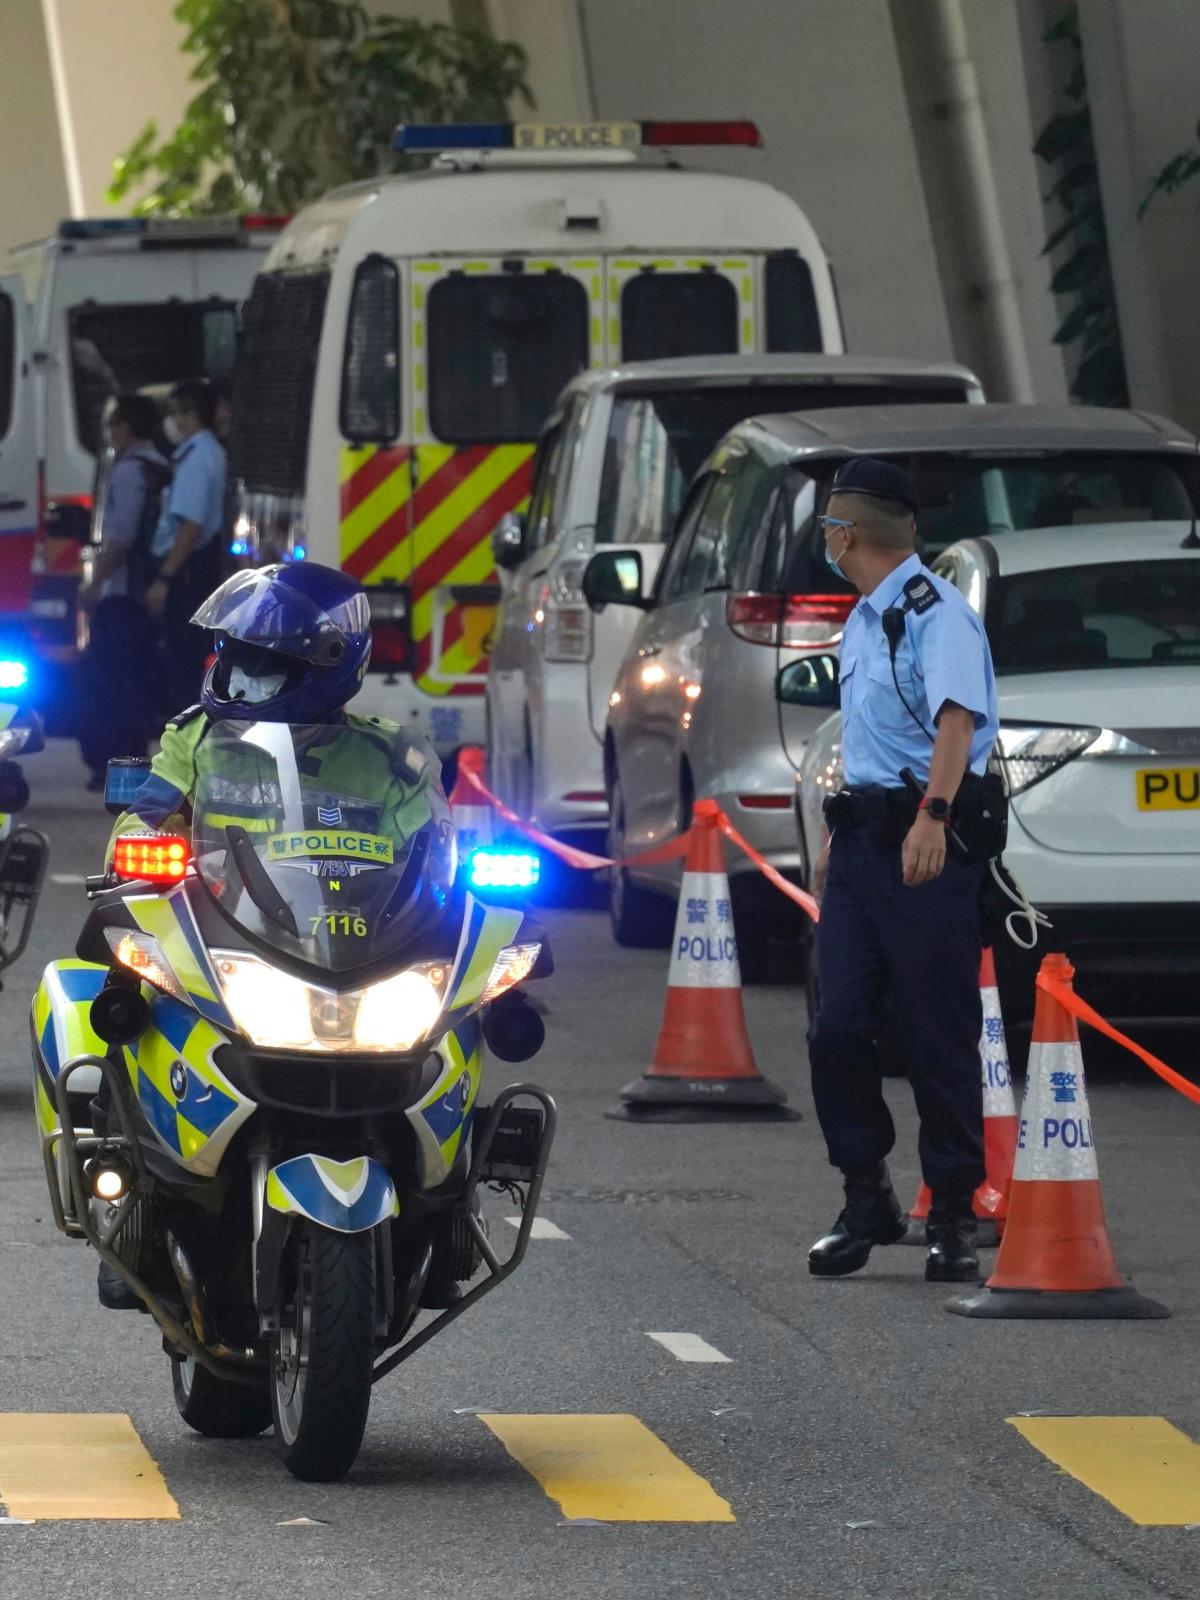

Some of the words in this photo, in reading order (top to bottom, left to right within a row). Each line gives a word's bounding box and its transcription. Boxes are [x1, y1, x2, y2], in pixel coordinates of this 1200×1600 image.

[545, 126, 612, 147] POLICE
[1144, 772, 1200, 804] PU
[290, 835, 372, 853] POLICE
[329, 880, 341, 891] N
[309, 915, 367, 937] 7116
[678, 936, 738, 961] POLIC
[1050, 1071, 1077, 1103] 警
